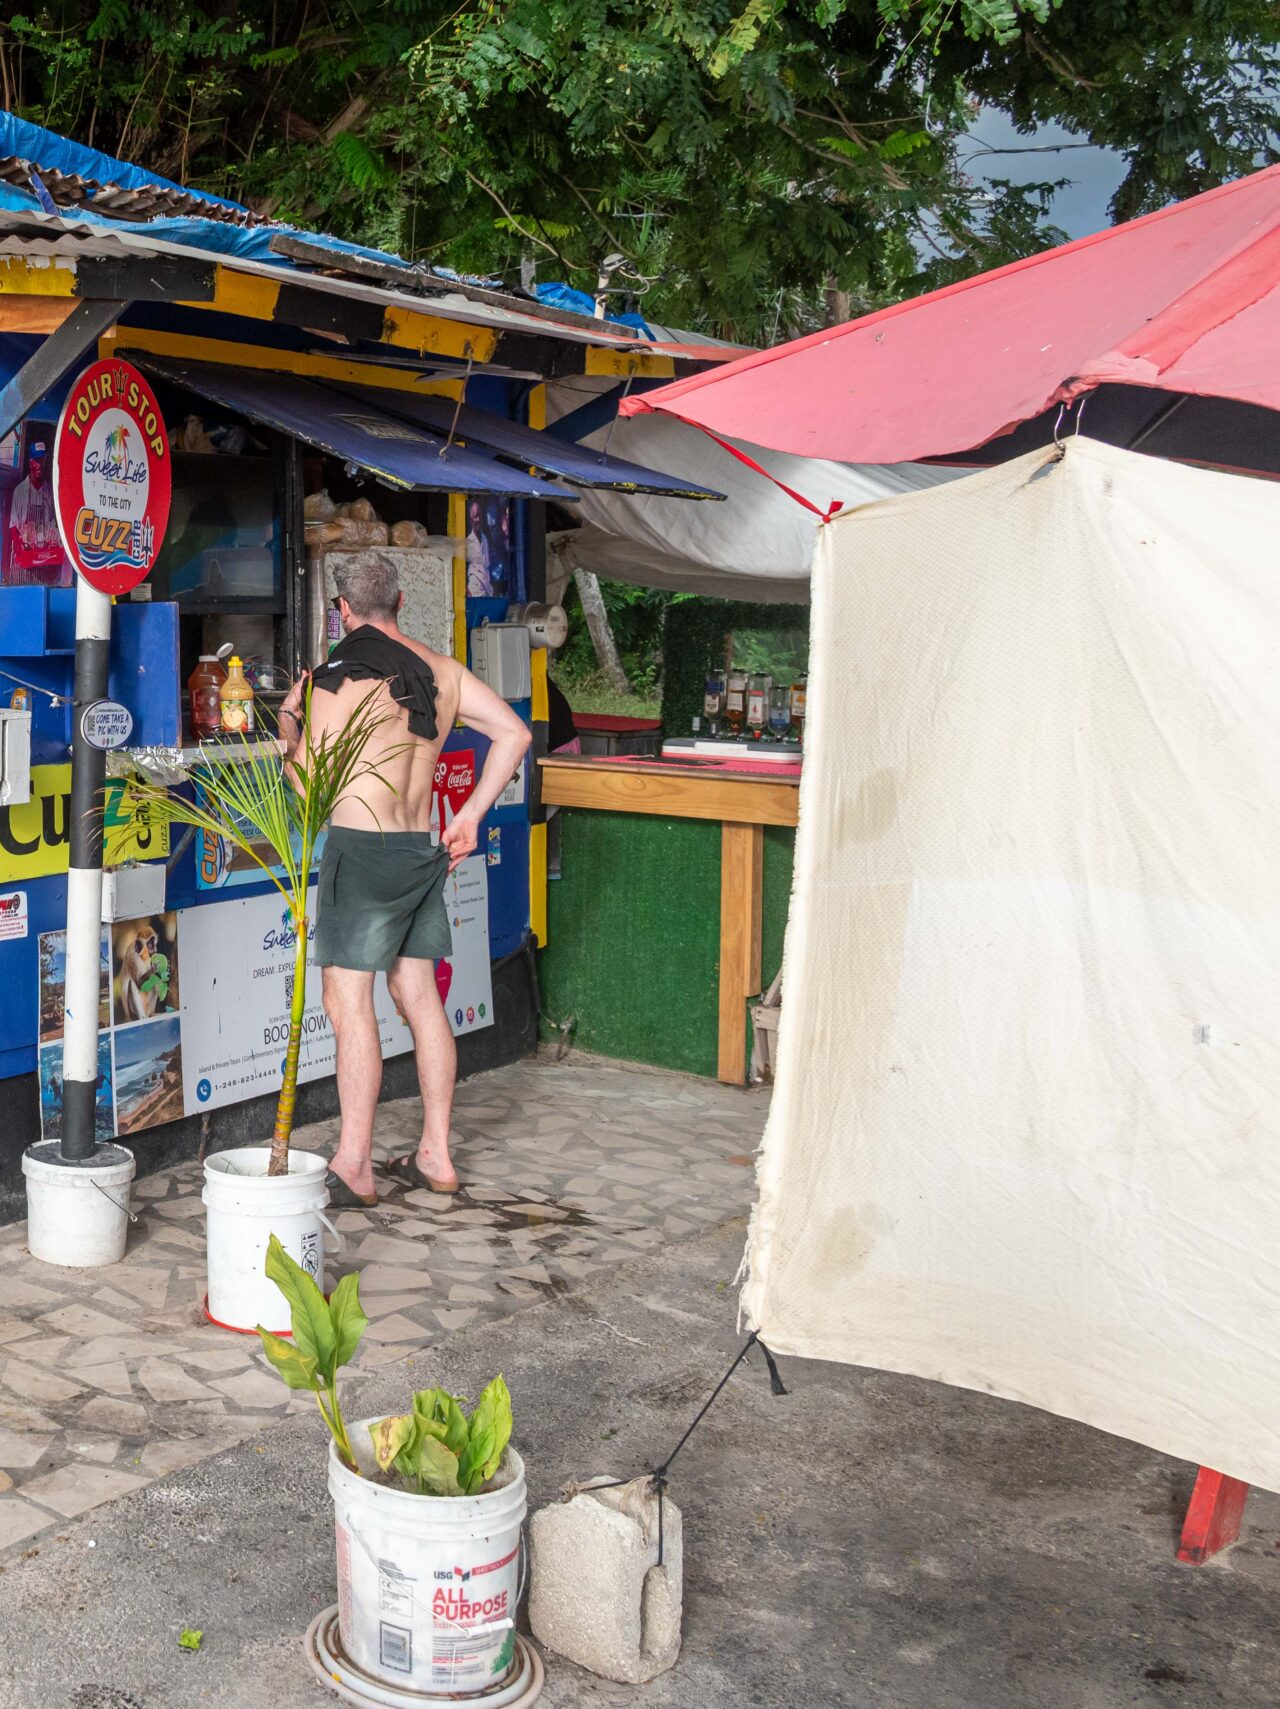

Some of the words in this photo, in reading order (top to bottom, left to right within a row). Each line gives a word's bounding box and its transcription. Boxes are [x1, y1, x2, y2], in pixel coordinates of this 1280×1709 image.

[68, 372, 113, 437] TOUR
[128, 381, 164, 457] STOP
[84, 451, 123, 479] Sweet
[121, 460, 147, 484] Life
[99, 494, 106, 507] TO
[108, 497, 119, 510] THE
[119, 498, 132, 511] CITY
[131, 519, 141, 559] cafe
[96, 713, 110, 724] COME
[111, 713, 124, 724] TAKE
[98, 725, 106, 736] PIC
[107, 725, 120, 736] WITH
[120, 725, 127, 735] US
[263, 1022, 292, 1045] BOO
[301, 1013, 328, 1034] NOW
[434, 1571, 453, 1580] USG
[433, 1587, 469, 1604] ALL
[433, 1590, 508, 1620] PURPOSE
